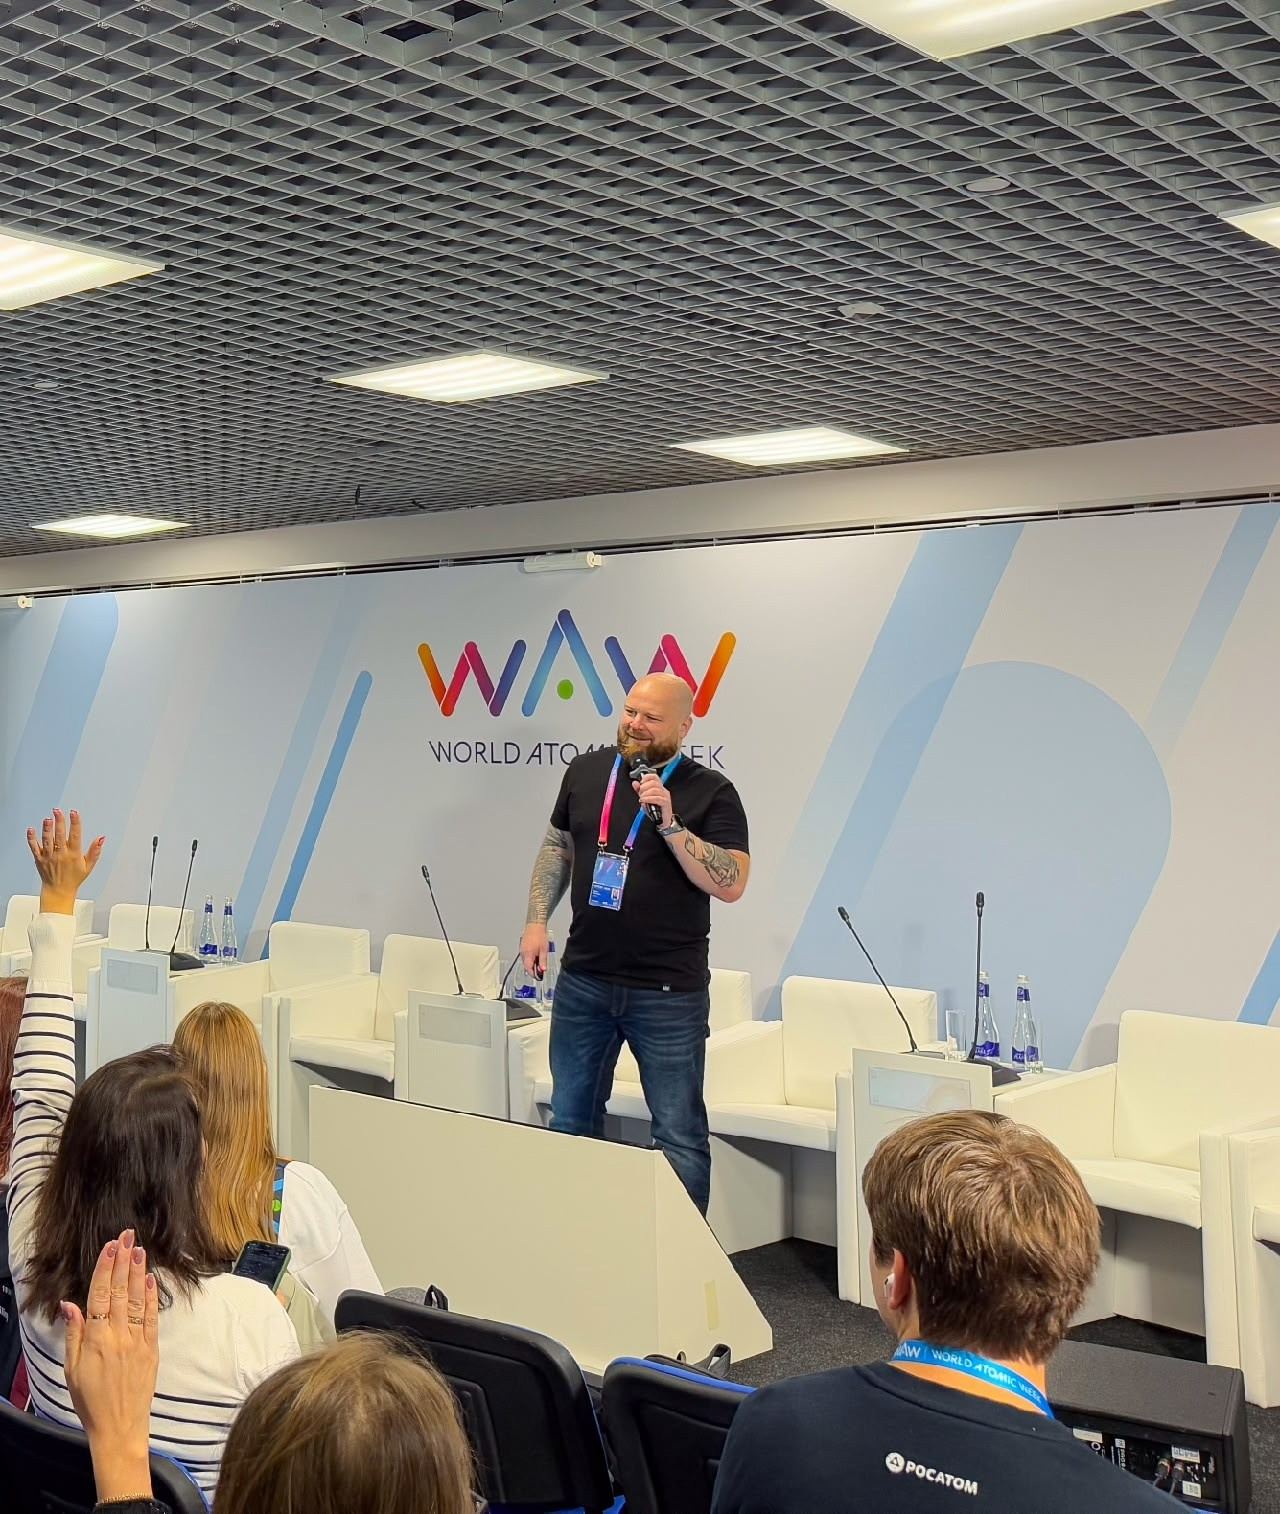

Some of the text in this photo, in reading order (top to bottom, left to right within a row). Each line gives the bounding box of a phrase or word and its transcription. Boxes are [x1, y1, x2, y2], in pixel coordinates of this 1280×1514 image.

[417, 608, 737, 718] WAW
[428, 740, 520, 765] WORLD
[931, 1348, 973, 1369] WORLD
[973, 1363, 1017, 1389] ATOMIC
[905, 1460, 978, 1496] РОСАТОМ
